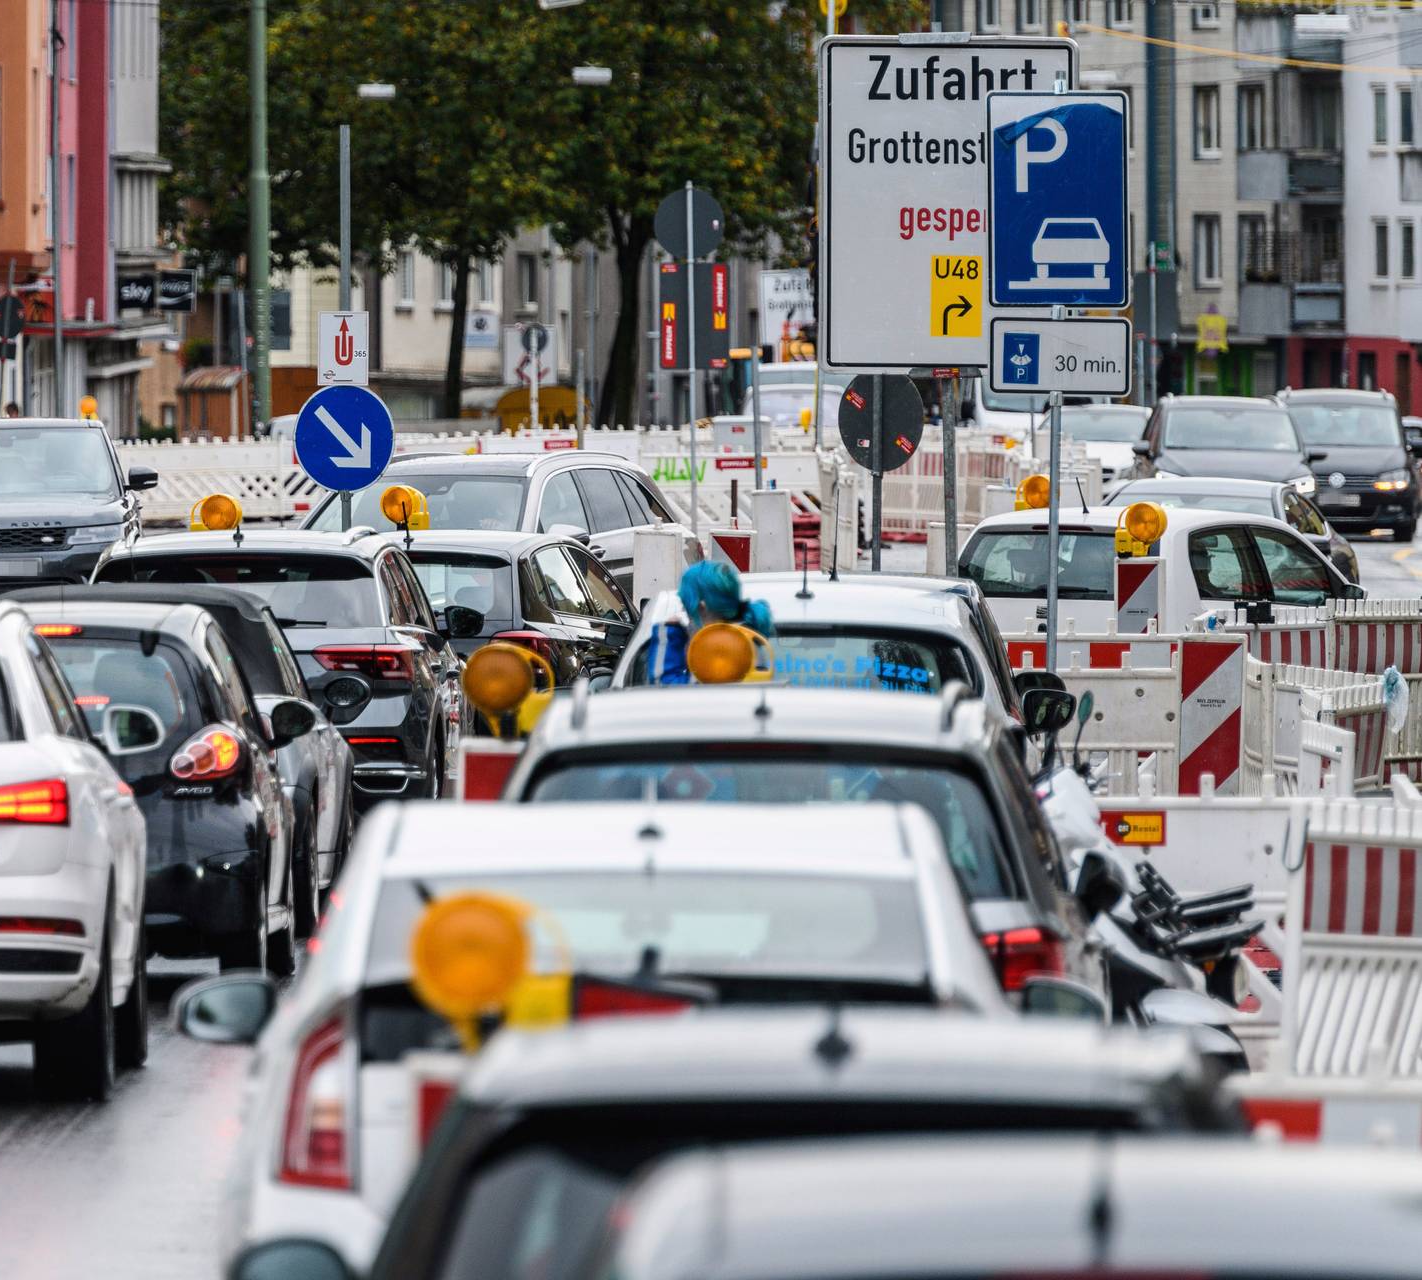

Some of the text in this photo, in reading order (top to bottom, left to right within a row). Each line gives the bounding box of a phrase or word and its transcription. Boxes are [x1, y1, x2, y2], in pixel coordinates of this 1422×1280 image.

[868, 55, 1037, 101] Zufahrt
[899, 206, 986, 241] gespe
[934, 258, 979, 280] U48
[121, 283, 152, 303] sky
[353, 350, 367, 358] 365
[1054, 354, 1122, 373] 30 min.
[855, 655, 930, 683] Pizza
